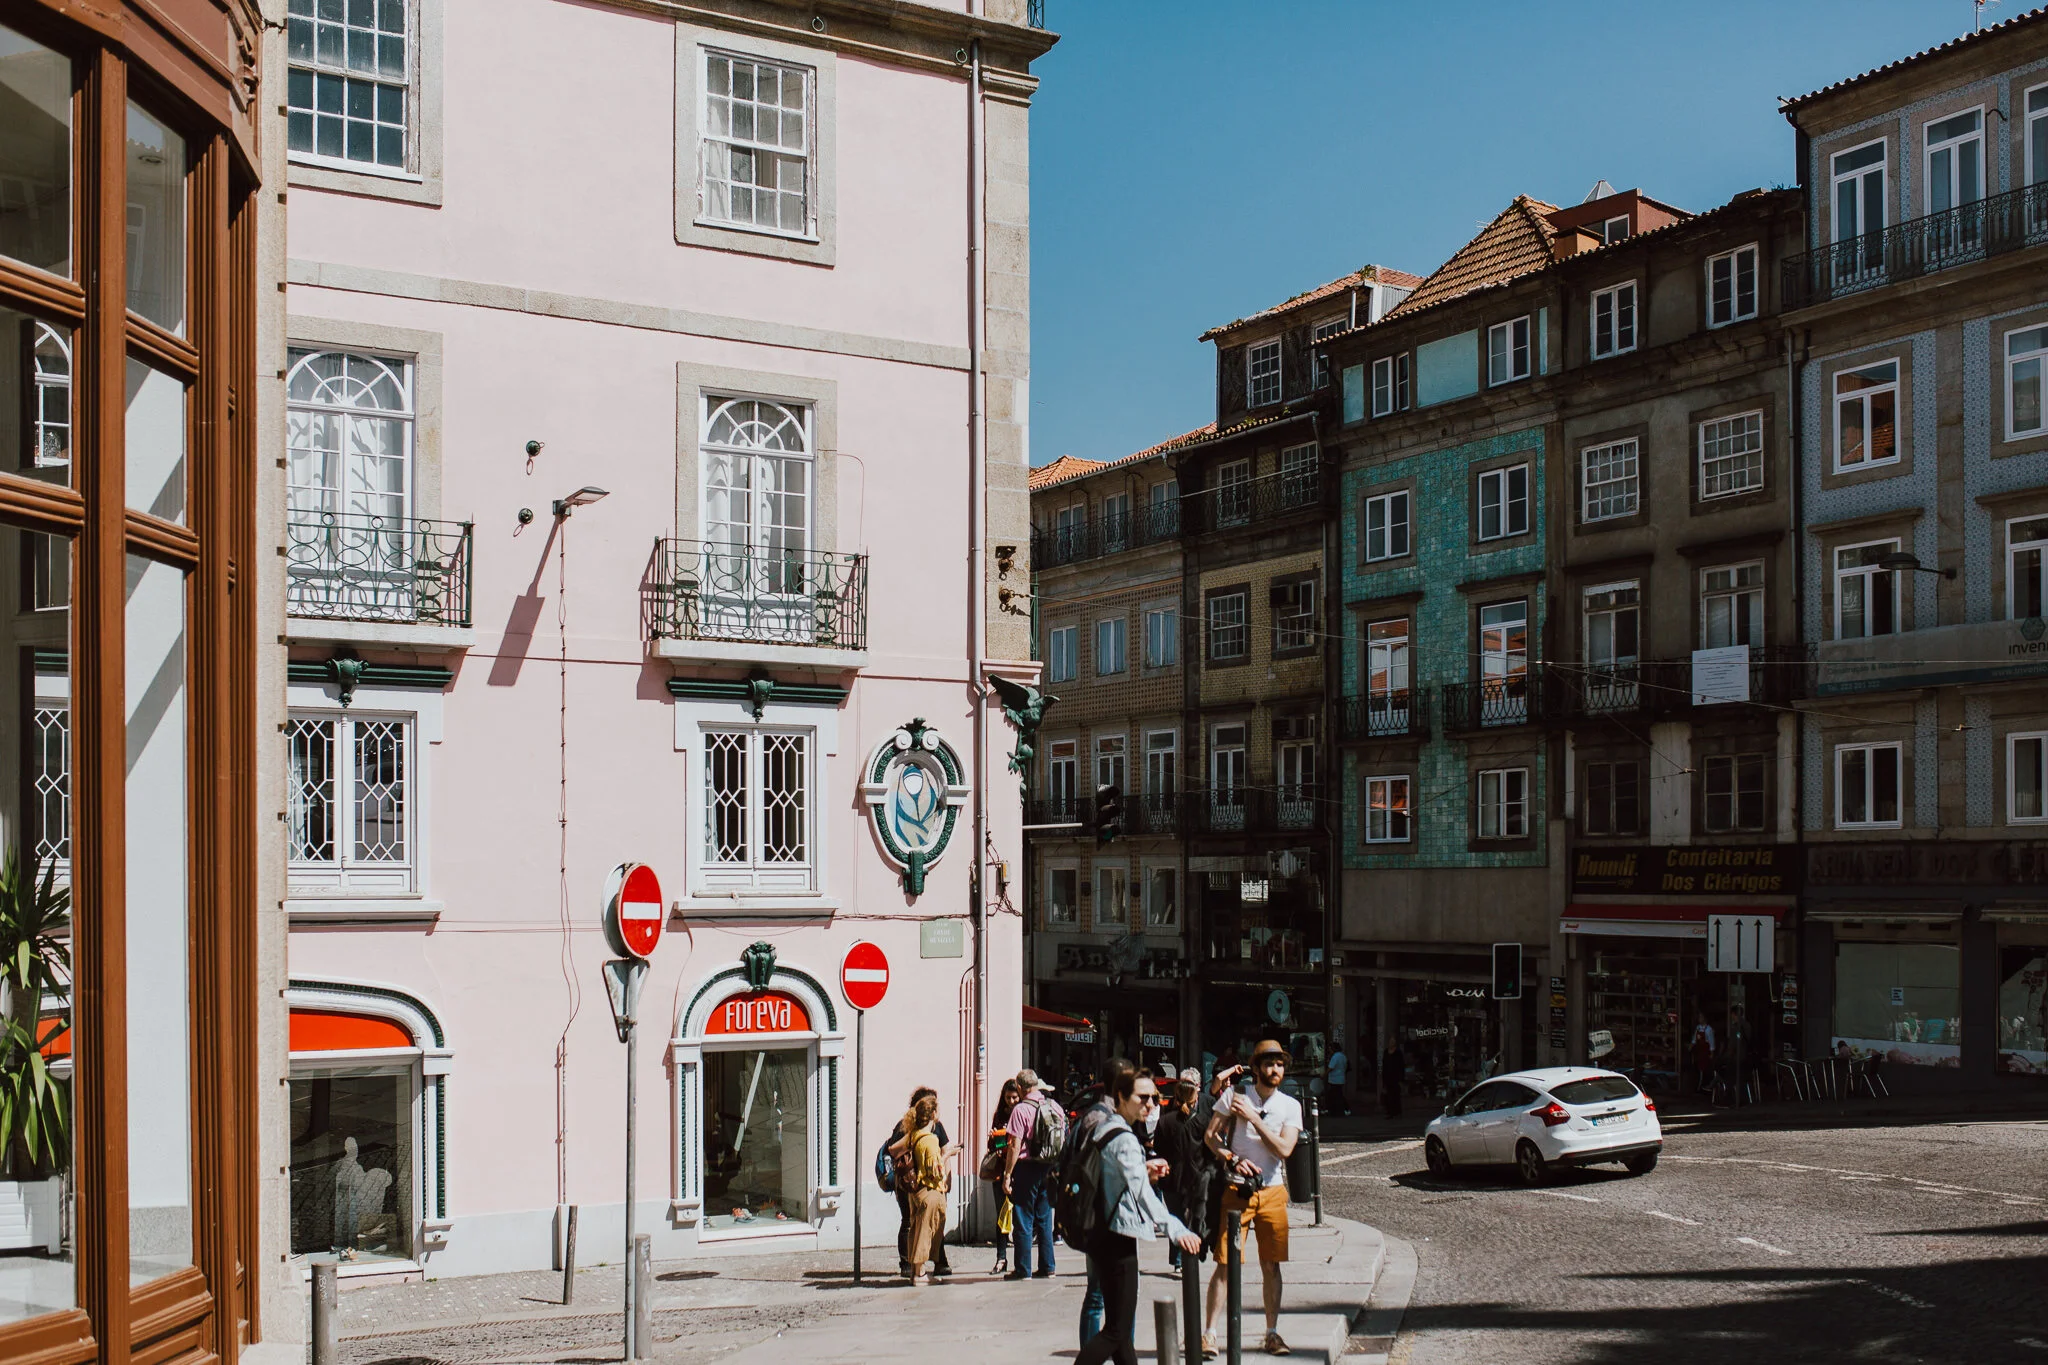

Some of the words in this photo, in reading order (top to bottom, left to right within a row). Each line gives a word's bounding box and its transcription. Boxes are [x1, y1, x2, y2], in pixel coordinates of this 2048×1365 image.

[1666, 847, 1773, 867] Confeitaria
[1661, 873, 1696, 890] Dos
[1703, 871, 1783, 893] Clérigos
[1145, 1034, 1175, 1047] OUTLET
